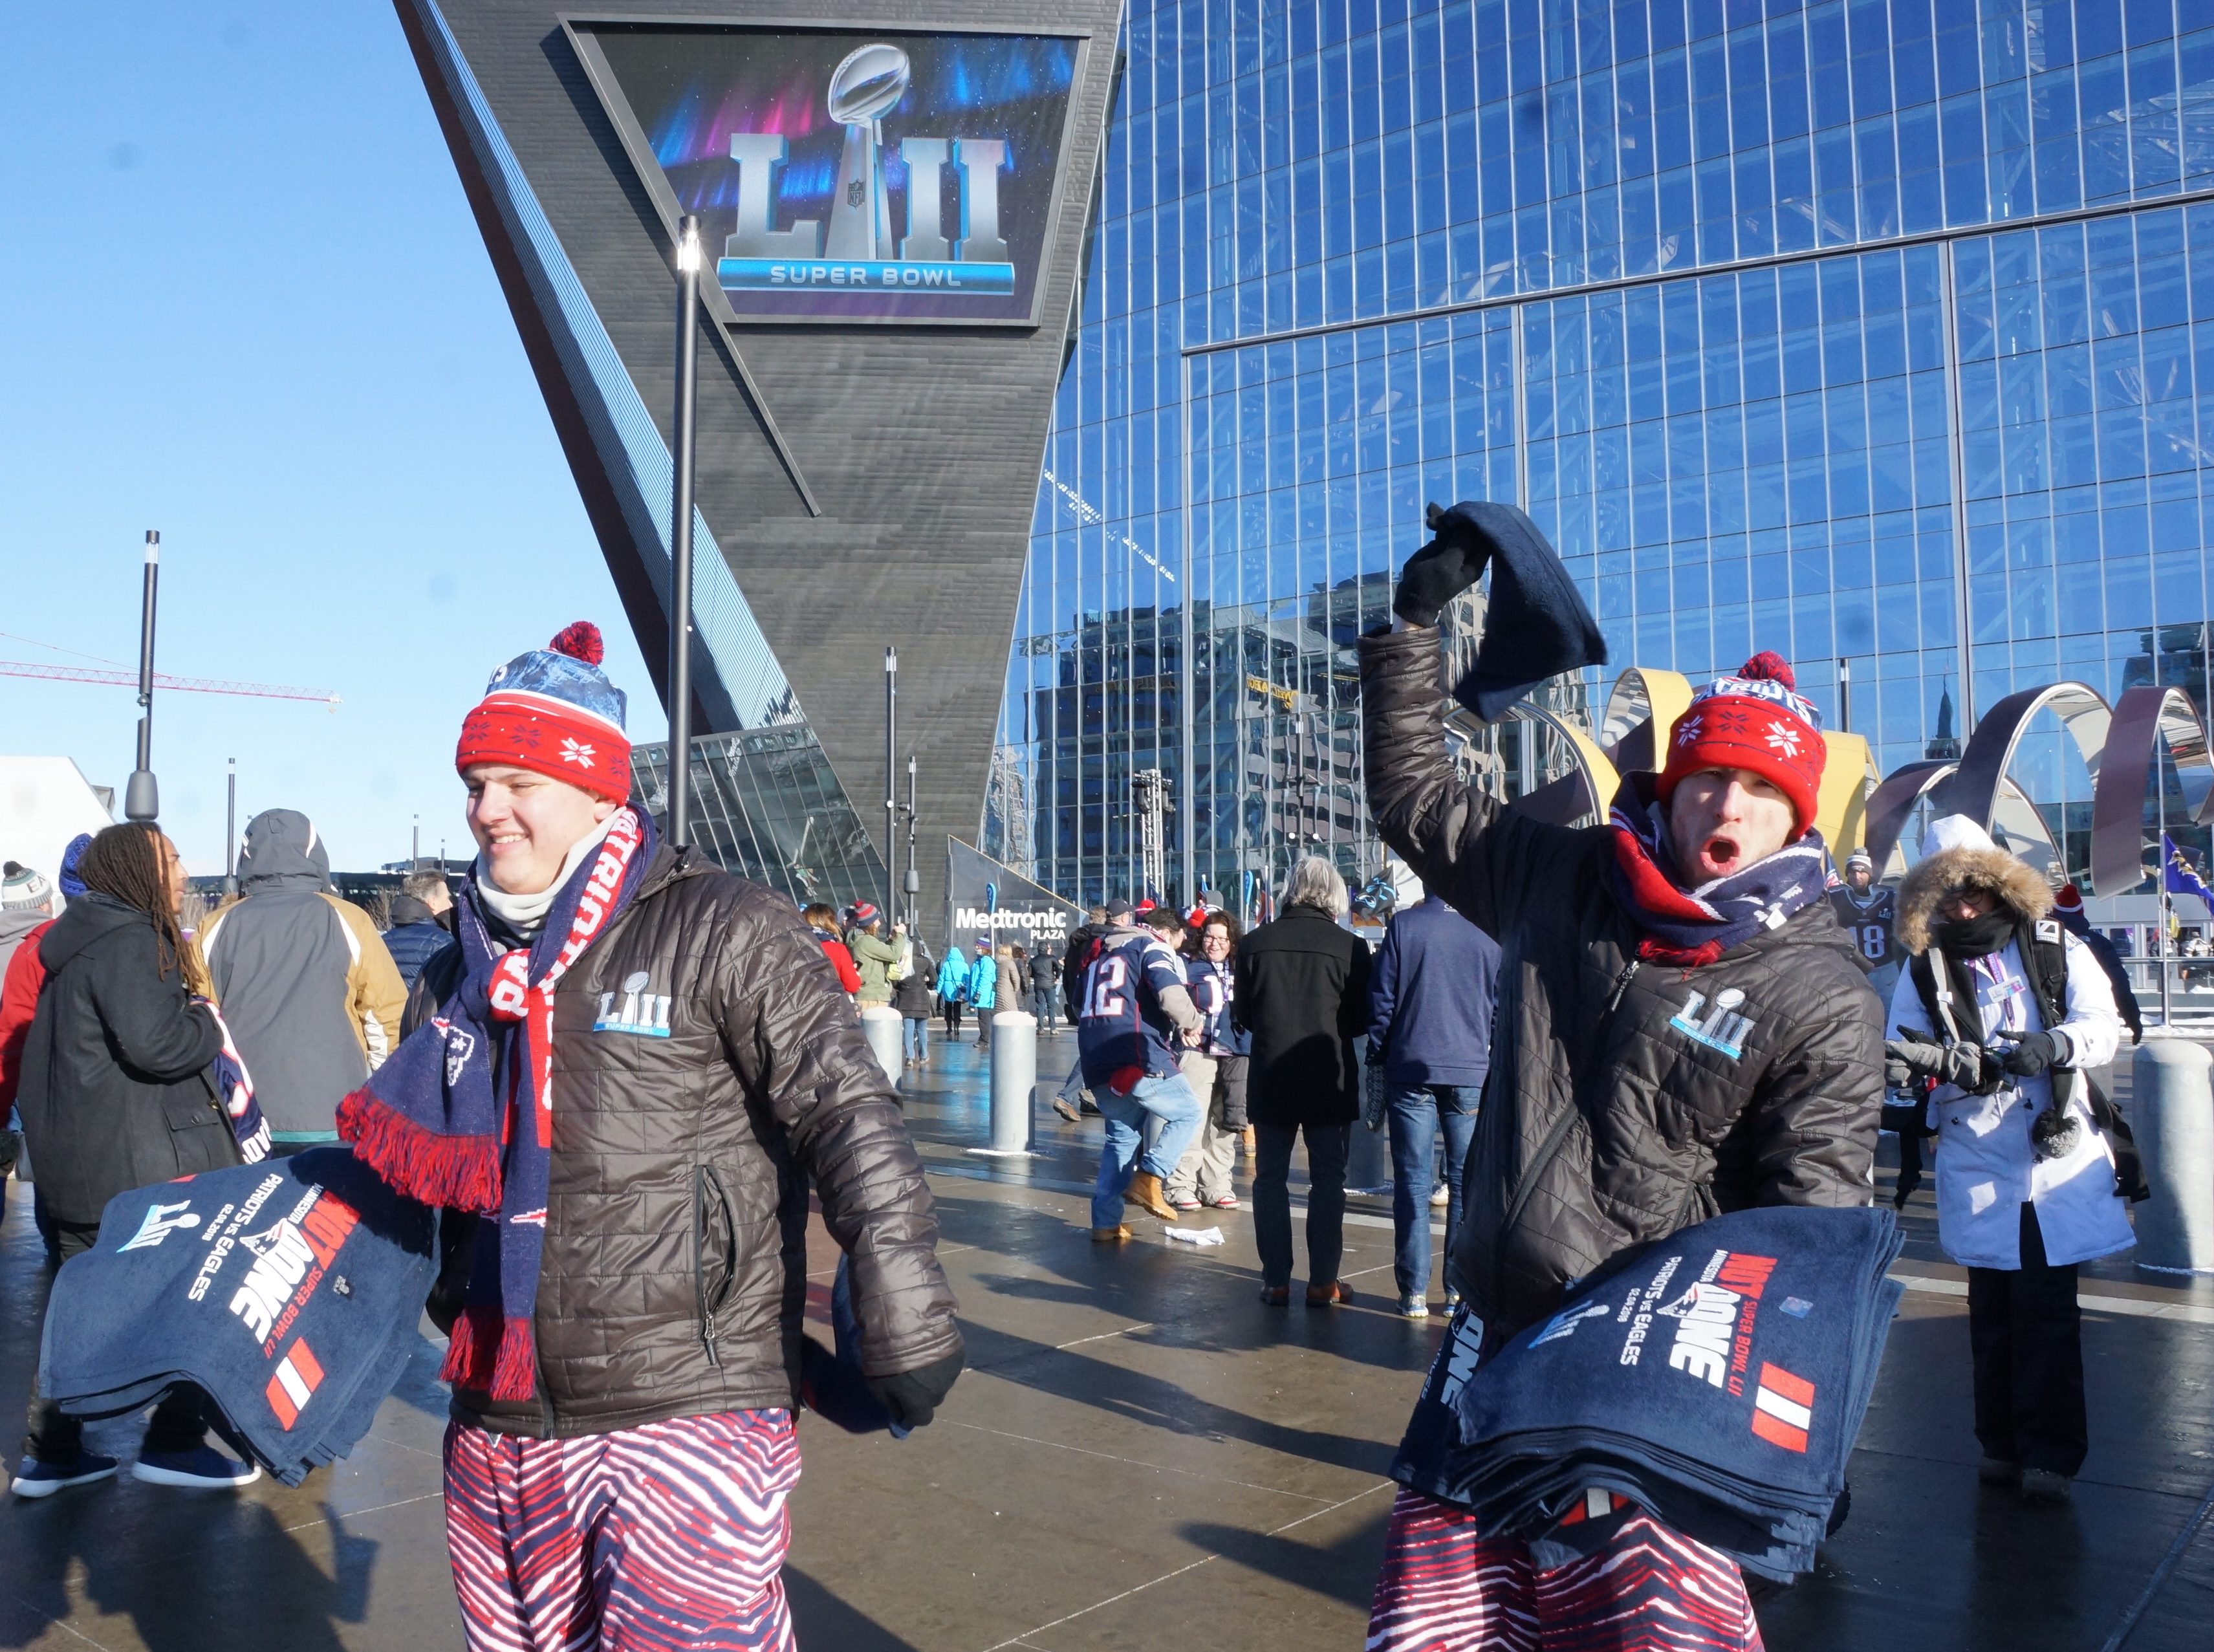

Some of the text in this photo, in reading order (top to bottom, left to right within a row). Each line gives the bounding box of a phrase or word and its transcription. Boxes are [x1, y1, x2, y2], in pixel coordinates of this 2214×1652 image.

[725, 132, 1008, 263] LII
[770, 265, 962, 287] SUPER BOWL
[955, 907, 1067, 929] Medtronic
[1030, 929, 1066, 940] PLAZA
[1081, 955, 1127, 1018] 12
[235, 1173, 283, 1226] PATRIOTS
[288, 1182, 324, 1225] MINNESOTA
[299, 1190, 362, 1272] NOT
[188, 1237, 235, 1301] EAGLES
[229, 1218, 315, 1344] DONE
[1645, 1255, 1683, 1300] PATRIOTS
[1699, 1249, 1729, 1283] MINNESOTA
[1717, 1252, 1778, 1300] NOT
[263, 1266, 323, 1359] SUPER BOWL LII
[1669, 1283, 1741, 1389] DONE
[1620, 1313, 1653, 1366] EAGLES
[1728, 1299, 1758, 1397] SUPER BOWL LII
